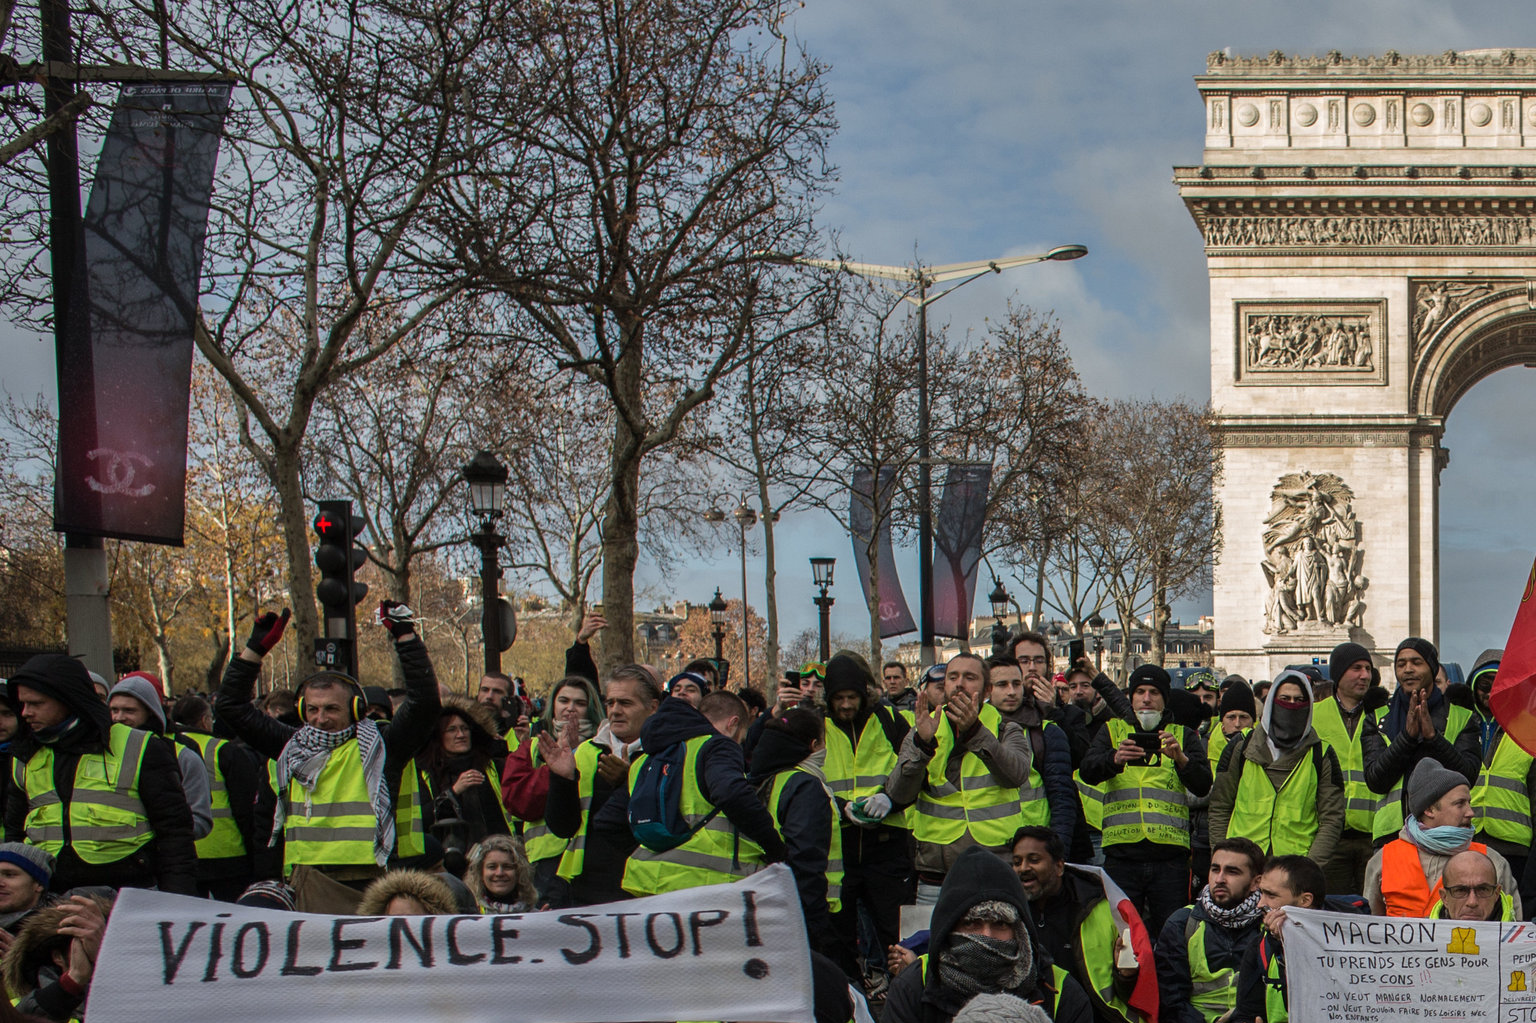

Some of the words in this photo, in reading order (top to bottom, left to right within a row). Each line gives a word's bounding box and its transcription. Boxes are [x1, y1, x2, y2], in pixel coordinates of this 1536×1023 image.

[1323, 922, 1436, 945] MACRON
[1317, 956, 1334, 968] TU
[1340, 957, 1395, 969] PRENDS
[1402, 957, 1420, 968] LES
[1425, 957, 1456, 968] GENS
[1461, 957, 1489, 967] POUR
[1349, 974, 1376, 985] DES
[1380, 975, 1414, 985] CONS
[1344, 993, 1370, 1001] VEUT
[1376, 994, 1411, 1002] MANGER
[1420, 994, 1485, 1002] NORMALEMENT
[1343, 1005, 1362, 1013] VEUT
[1424, 1009, 1437, 1017] DES
